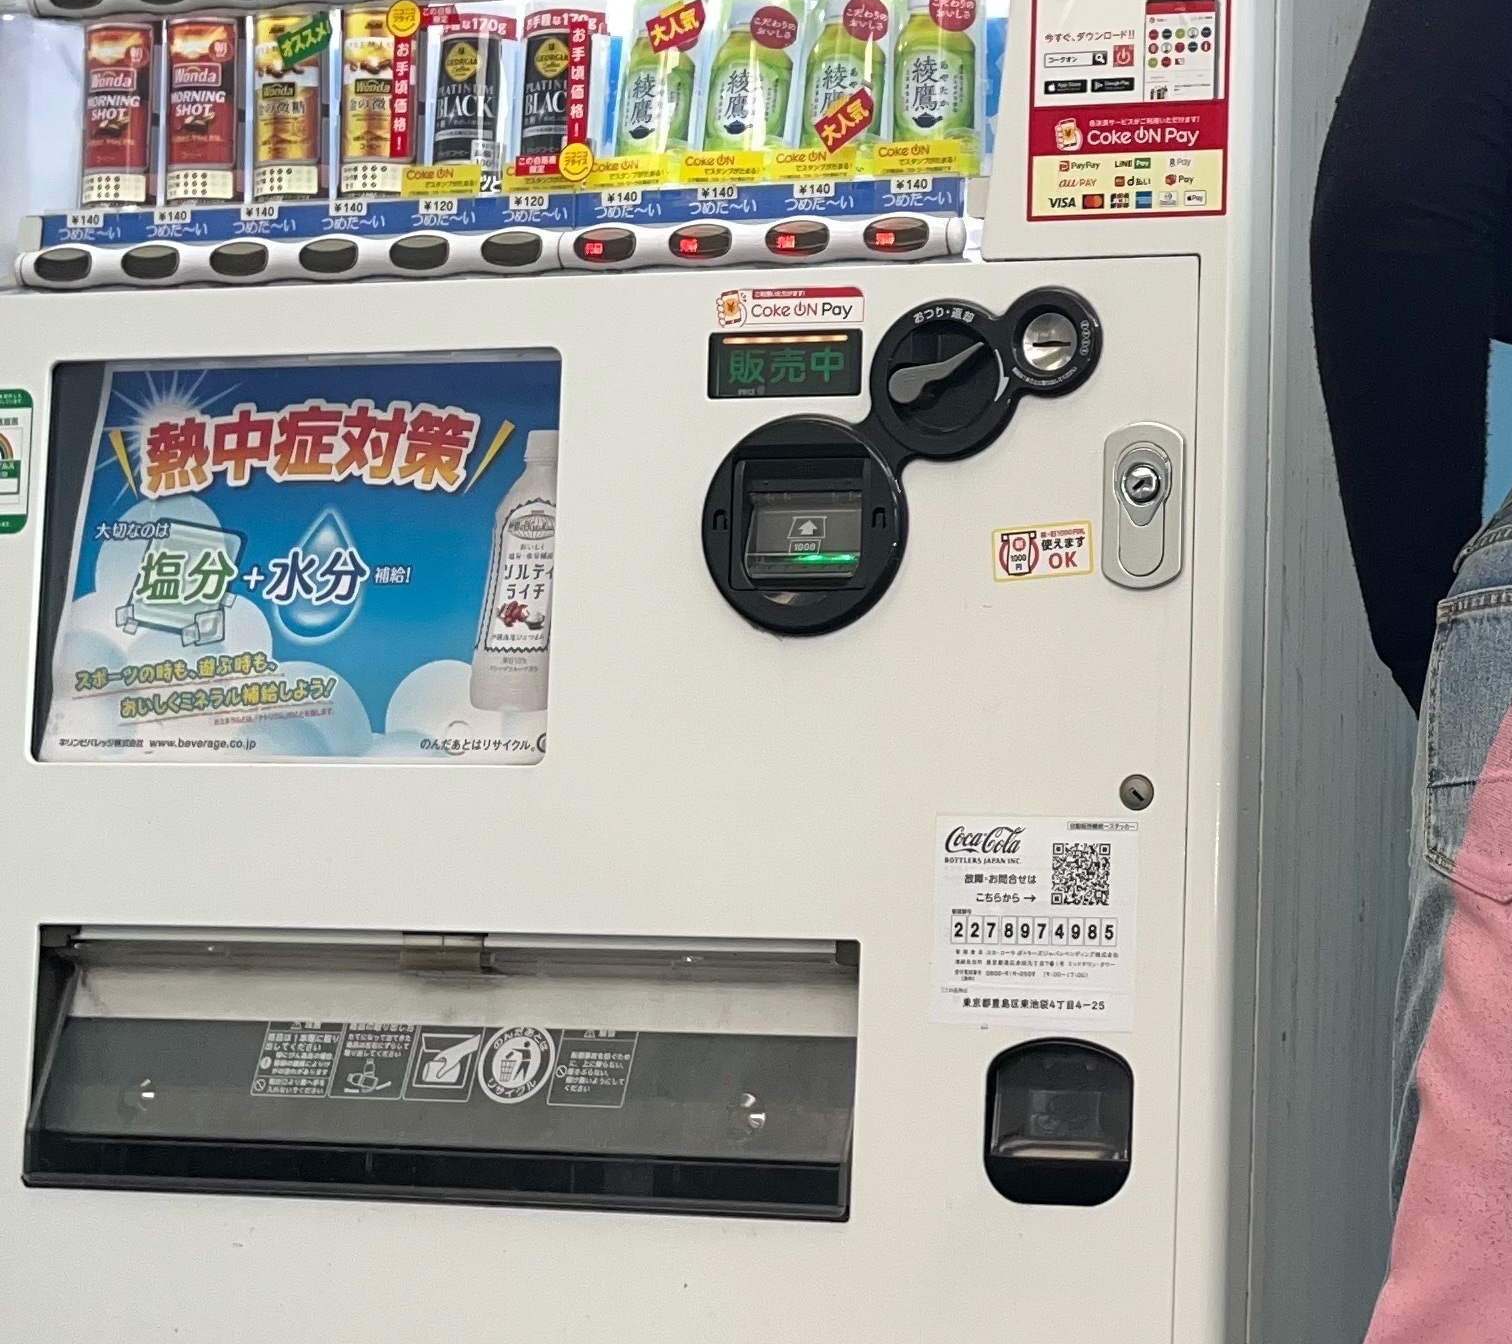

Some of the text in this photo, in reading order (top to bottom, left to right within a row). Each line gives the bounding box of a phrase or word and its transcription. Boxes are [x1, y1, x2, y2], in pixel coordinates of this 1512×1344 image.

[937, 7, 970, 20] おいしさ
[651, 11, 701, 45] 大人気
[753, 17, 797, 32] こだわりの
[756, 26, 792, 39] おいしさ
[281, 23, 332, 57] オススメ!
[91, 72, 132, 88] Wonda
[175, 67, 218, 83] Wonda
[912, 56, 938, 111] 綾鷹
[91, 107, 127, 122] SHOT
[175, 103, 213, 117] SHOT
[436, 96, 495, 118] BLACK
[820, 100, 870, 146] 大人気
[1087, 123, 1200, 147] Coke ON Pay
[1070, 160, 1100, 172] PayPay
[1079, 178, 1097, 187] PAY
[424, 201, 453, 211] ¥120
[514, 196, 544, 207] ¥120
[1048, 197, 1076, 209] VISA
[751, 298, 854, 320] Coke ON Pay
[728, 348, 846, 385] 販売中
[141, 400, 478, 496] 熱中症対策
[95, 521, 170, 540] 大切なのは
[1042, 536, 1085, 551] 使えます
[1049, 551, 1077, 569] OK
[374, 567, 411, 586] 補給!
[507, 584, 544, 600] ライチ
[75, 653, 278, 691] スポーツの時も、遊ぶ時も、
[121, 678, 336, 717] おいしくミネラル補給しよう!
[150, 739, 256, 749] www.beverage.co.jp
[420, 737, 536, 753] のんだあとはリサイクル。
[945, 825, 1026, 854] Coca-Cola
[983, 857, 1006, 865] JAPAN
[964, 874, 1036, 884] 故障・お問合せは
[976, 893, 1020, 903] こちらから
[954, 922, 1114, 940] 2278974985
